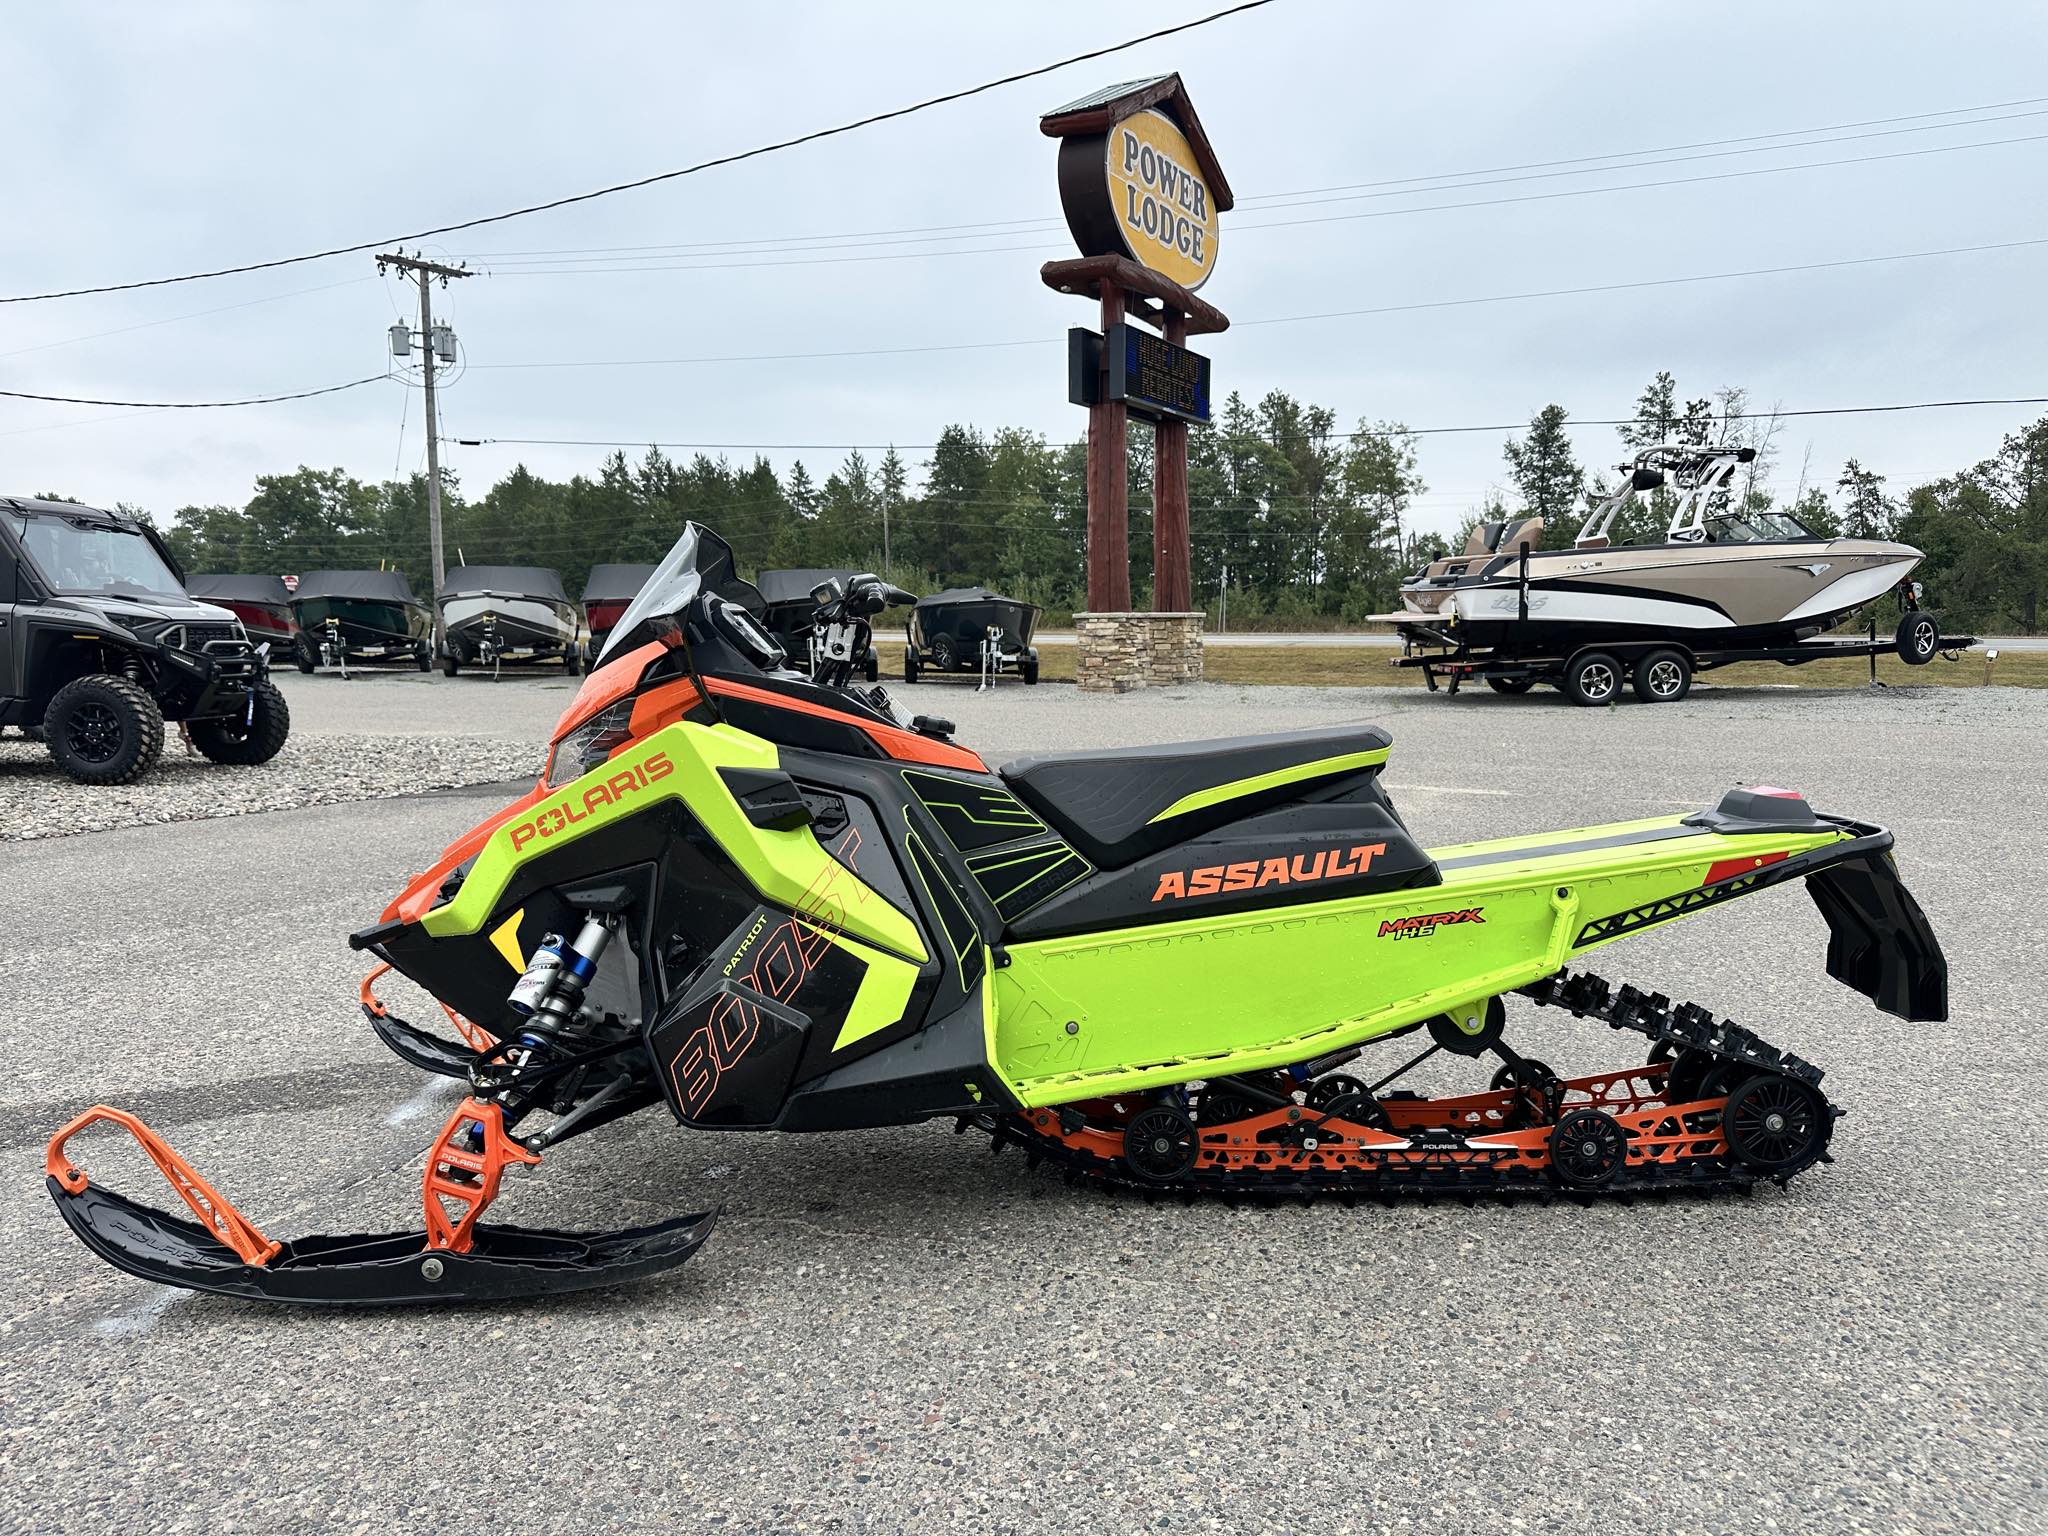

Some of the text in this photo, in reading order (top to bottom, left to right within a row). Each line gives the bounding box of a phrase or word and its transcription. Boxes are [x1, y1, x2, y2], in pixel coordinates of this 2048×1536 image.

[1123, 130, 1207, 222] POWER
[1127, 184, 1204, 264] LODGE
[509, 751, 675, 853] POLARIS
[1151, 843, 1387, 902] ASSAULT
[723, 913, 769, 978] PATRIOT
[1377, 907, 1486, 938] MATRYX
[1393, 925, 1436, 941] 146
[670, 827, 871, 1120] BOOST
[441, 1153, 483, 1171] POLARIS
[109, 1221, 225, 1267] POLARIS
